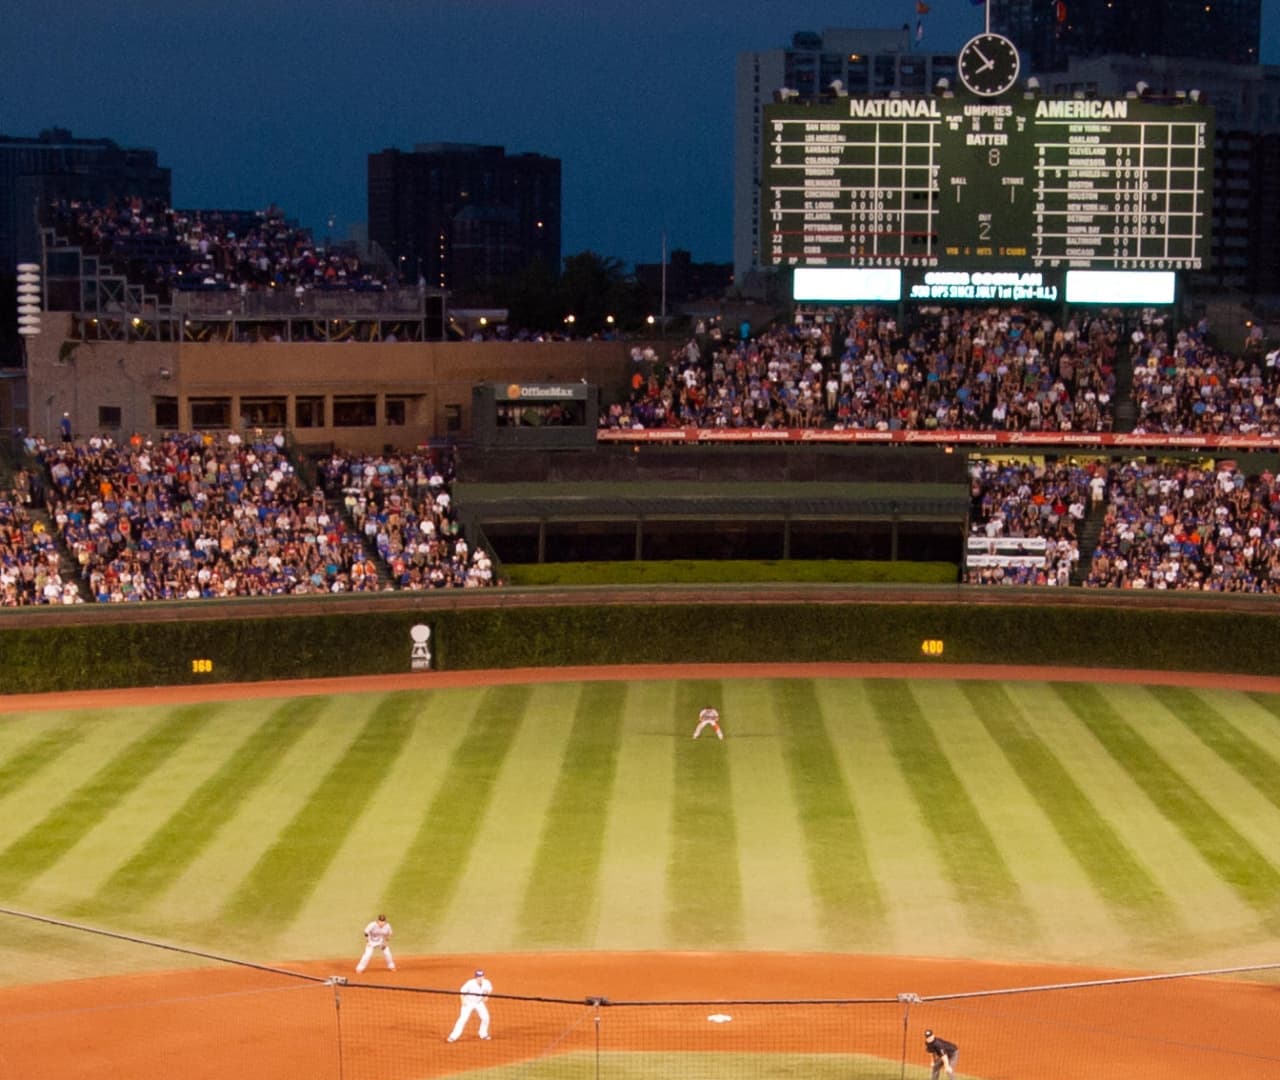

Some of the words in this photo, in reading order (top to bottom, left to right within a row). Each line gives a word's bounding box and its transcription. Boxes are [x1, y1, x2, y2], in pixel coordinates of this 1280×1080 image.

[850, 99, 941, 117] NATIONAL
[964, 105, 1012, 116] UMPIRES
[1035, 100, 1128, 118] AMERICAN
[966, 134, 1008, 146] BATTER
[988, 148, 1000, 167] 8
[979, 222, 992, 240] 2
[521, 387, 573, 397] OfficeMax
[922, 640, 943, 654] 400
